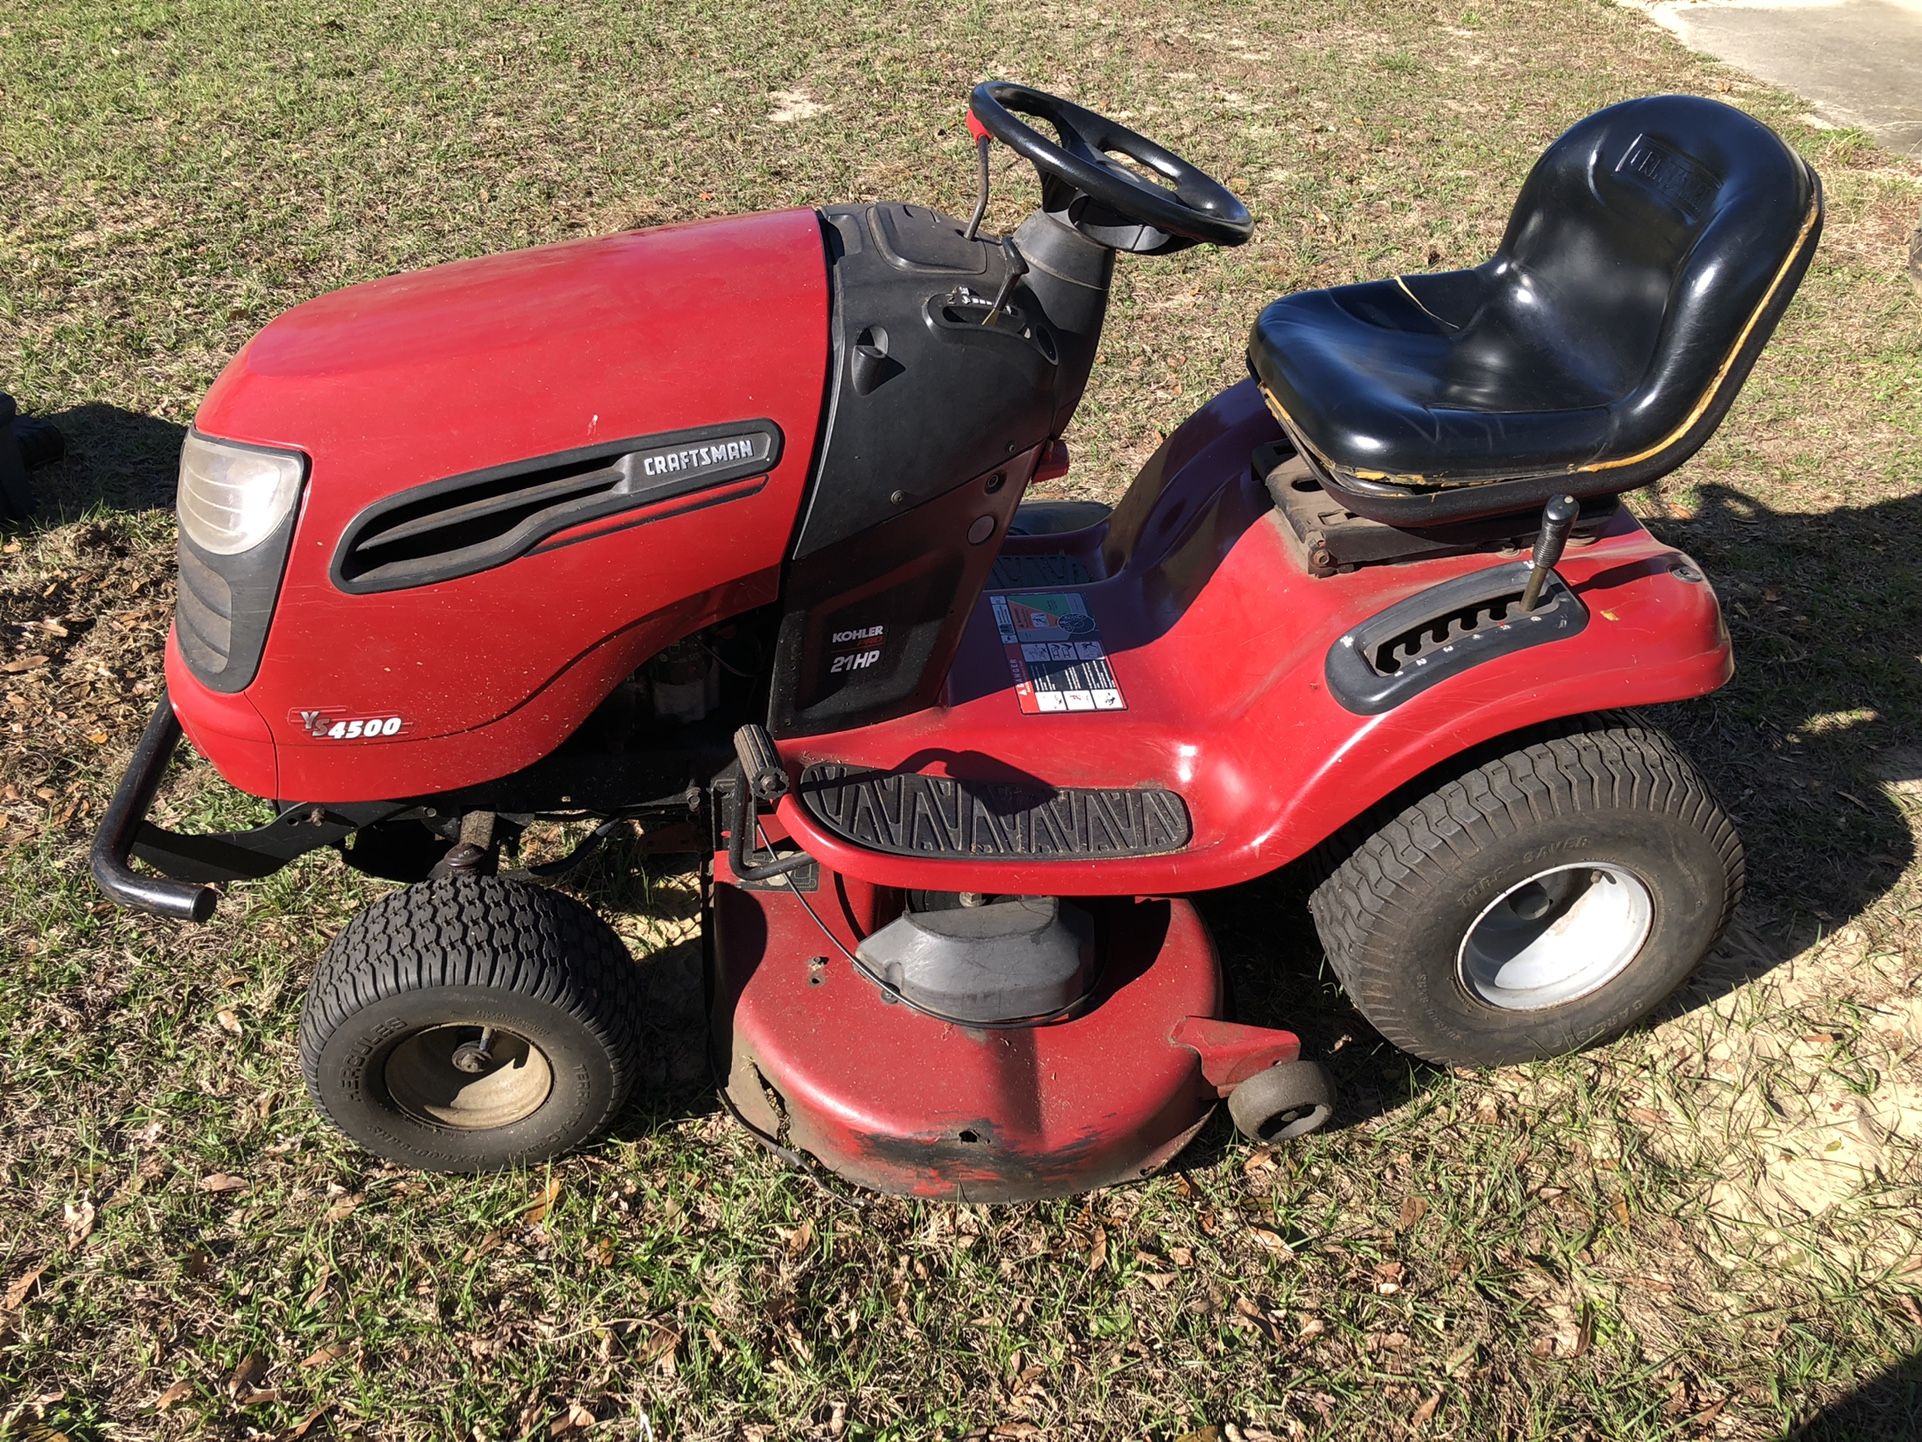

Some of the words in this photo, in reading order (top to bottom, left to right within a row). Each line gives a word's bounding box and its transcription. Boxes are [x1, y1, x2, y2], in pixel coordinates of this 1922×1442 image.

[643, 439, 754, 476] CRAFTSMAN
[832, 625, 884, 643] KOHLER
[830, 650, 880, 673] 21HP
